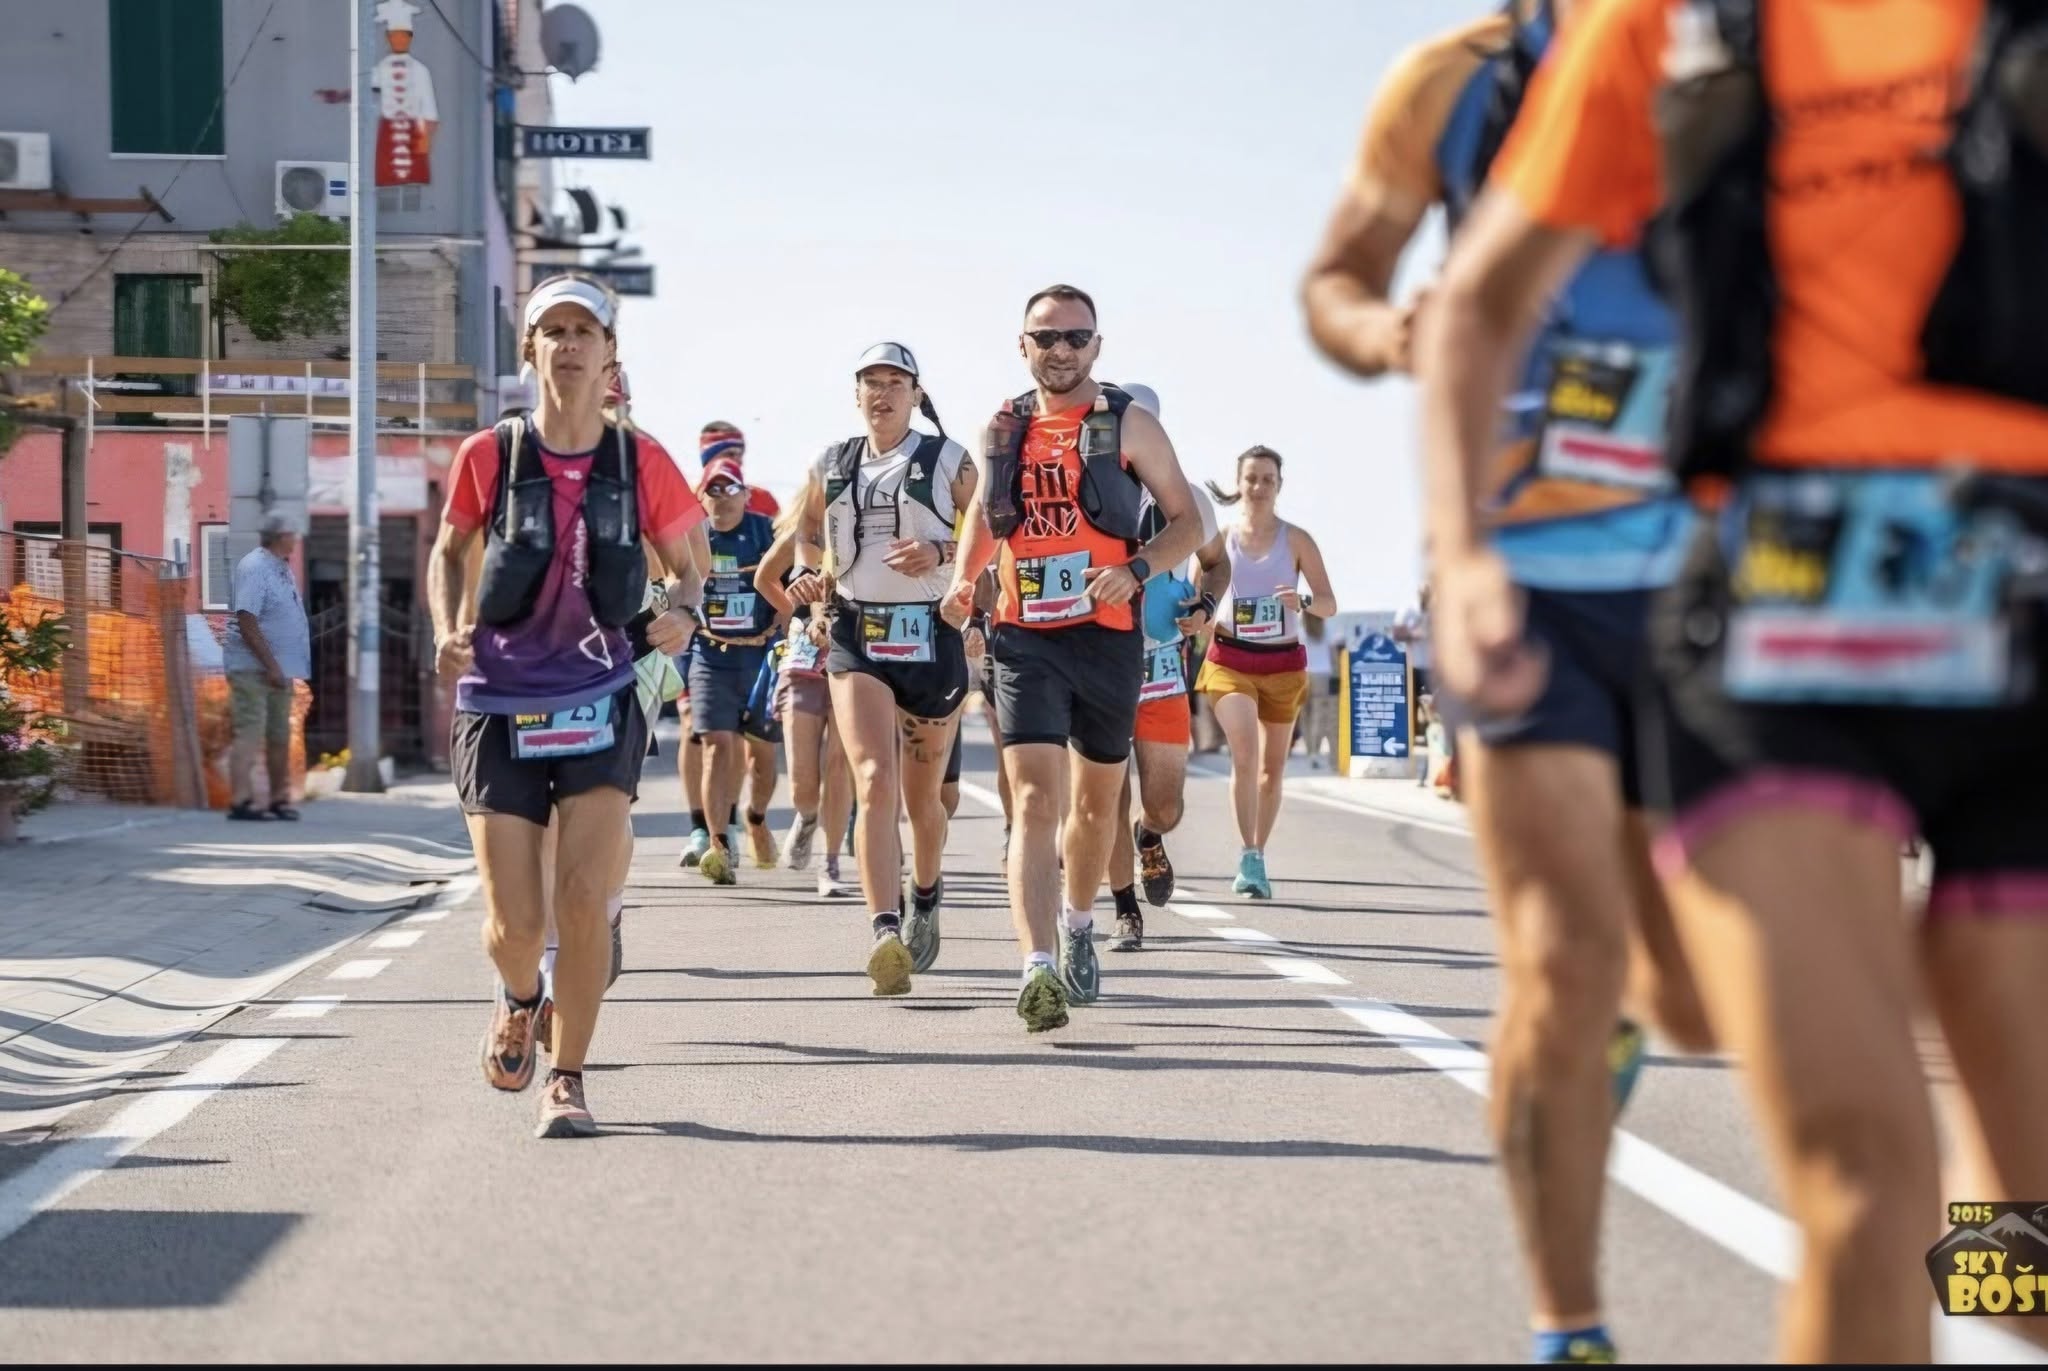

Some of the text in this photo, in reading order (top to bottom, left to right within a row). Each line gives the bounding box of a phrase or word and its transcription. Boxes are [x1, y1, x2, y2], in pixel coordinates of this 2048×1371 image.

[532, 133, 642, 153] HOTEL
[1059, 569, 1072, 591] 8
[901, 617, 919, 638] 14
